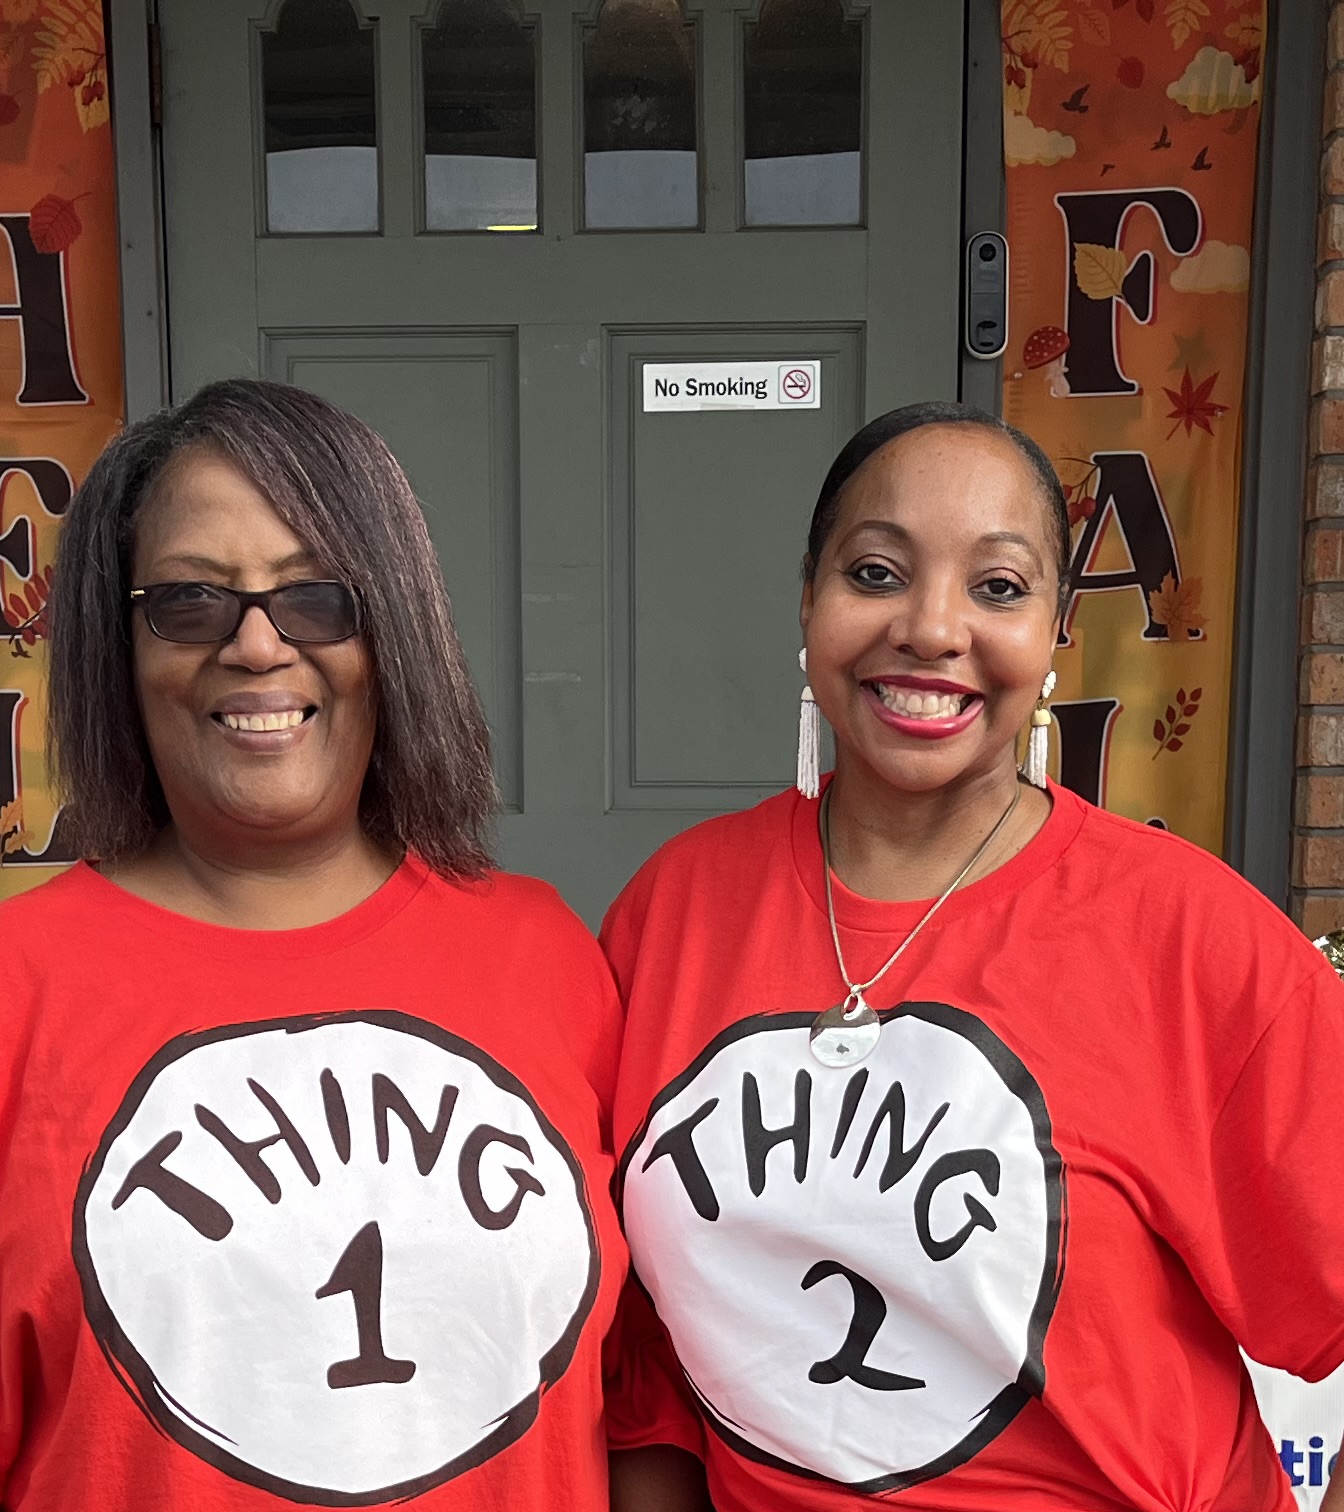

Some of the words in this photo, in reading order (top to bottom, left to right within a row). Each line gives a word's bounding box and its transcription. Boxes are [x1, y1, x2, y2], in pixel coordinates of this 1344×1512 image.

[654, 378, 680, 397] No
[685, 376, 768, 399] Smoking
[111, 1067, 546, 1241] THING
[641, 1066, 1001, 1262] THING
[315, 1220, 417, 1389] 1
[800, 1259, 927, 1392] 2
